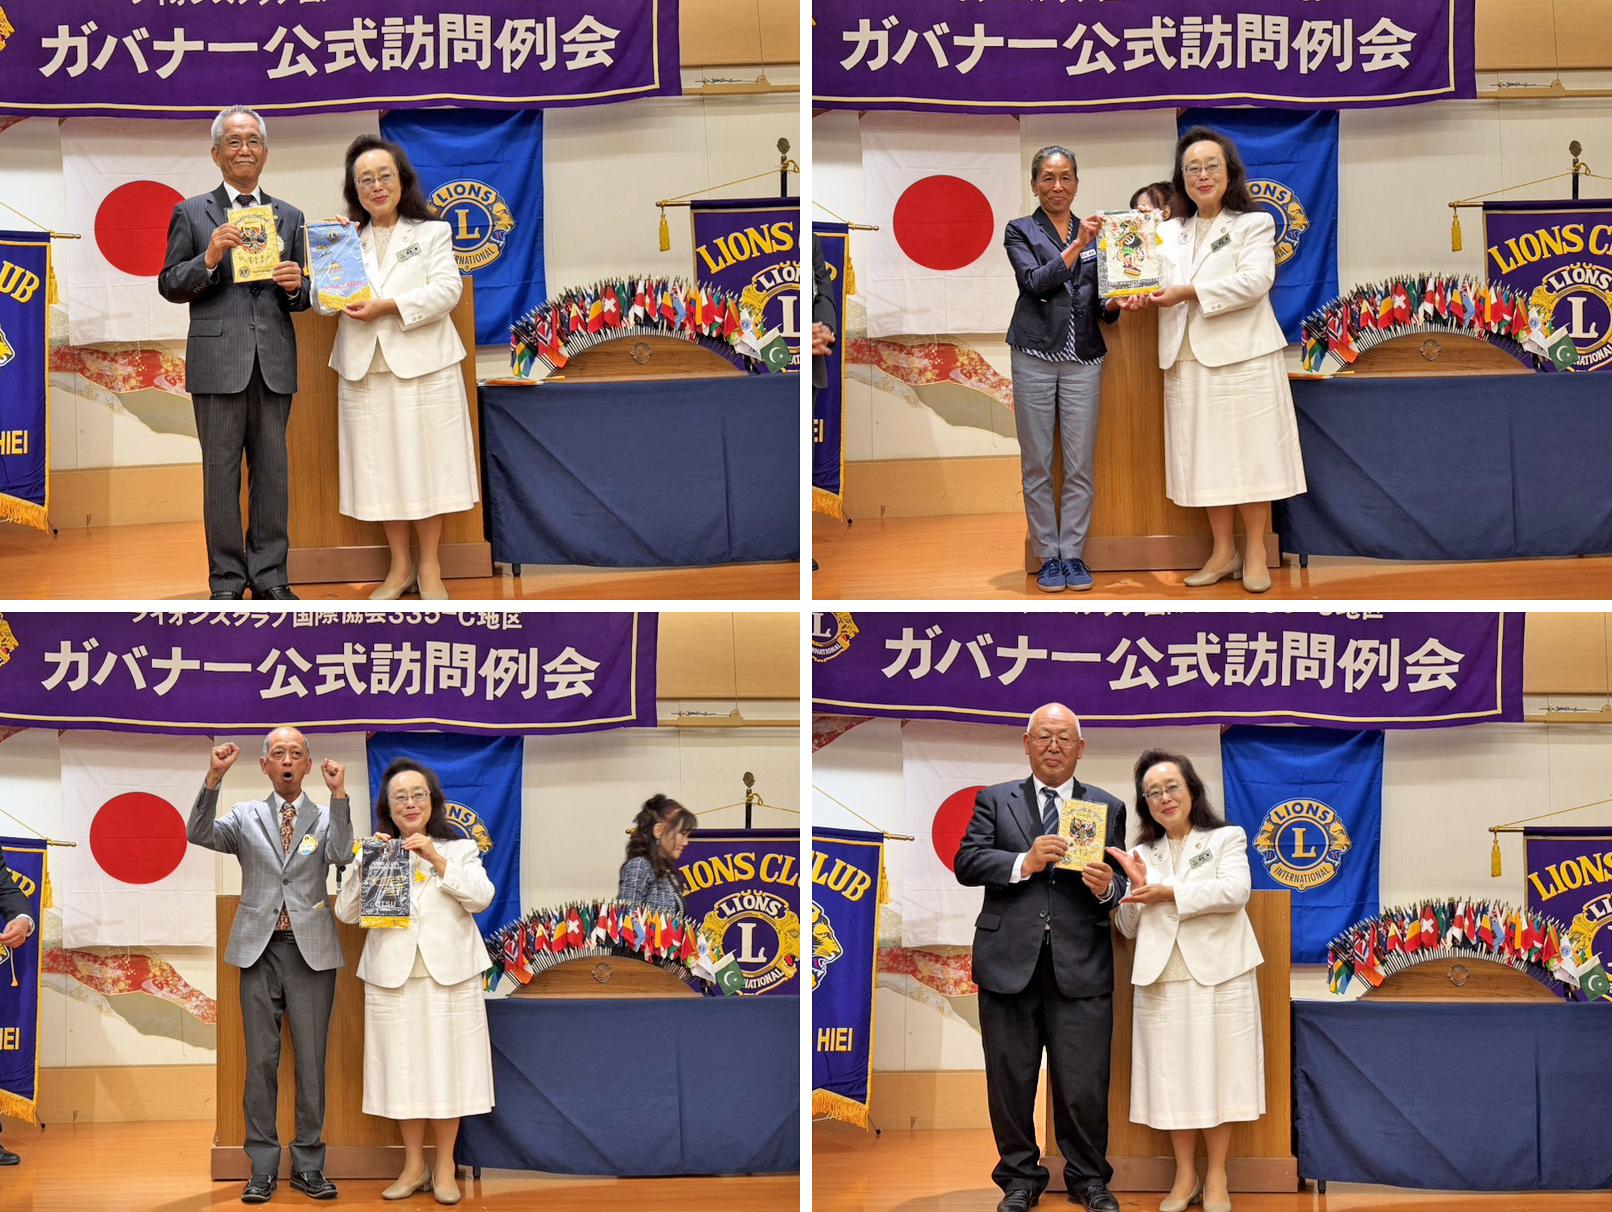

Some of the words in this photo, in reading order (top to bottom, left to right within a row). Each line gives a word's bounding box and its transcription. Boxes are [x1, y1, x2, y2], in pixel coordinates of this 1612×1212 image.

[39, 13, 621, 80] ガバナー公式訪問例会
[840, 13, 1417, 76] ガバナー公式訪問例会
[436, 183, 493, 204] LIONS
[455, 209, 480, 240] L
[696, 221, 794, 274] LIONS
[1488, 223, 1585, 275] LIONS
[1548, 267, 1611, 291] LIONS
[1567, 297, 1599, 339] L
[41, 637, 601, 700] ガバナー公式訪問例会
[882, 624, 1465, 694] ガバナー公式訪問例会
[1273, 802, 1330, 822] LIONS
[1292, 827, 1317, 858] L
[812, 850, 872, 902] LUB
[1273, 866, 1331, 884] INTERNATIONAL
[720, 893, 782, 917] LIONS
[737, 922, 767, 963] L
[817, 1027, 853, 1052] HIEI
